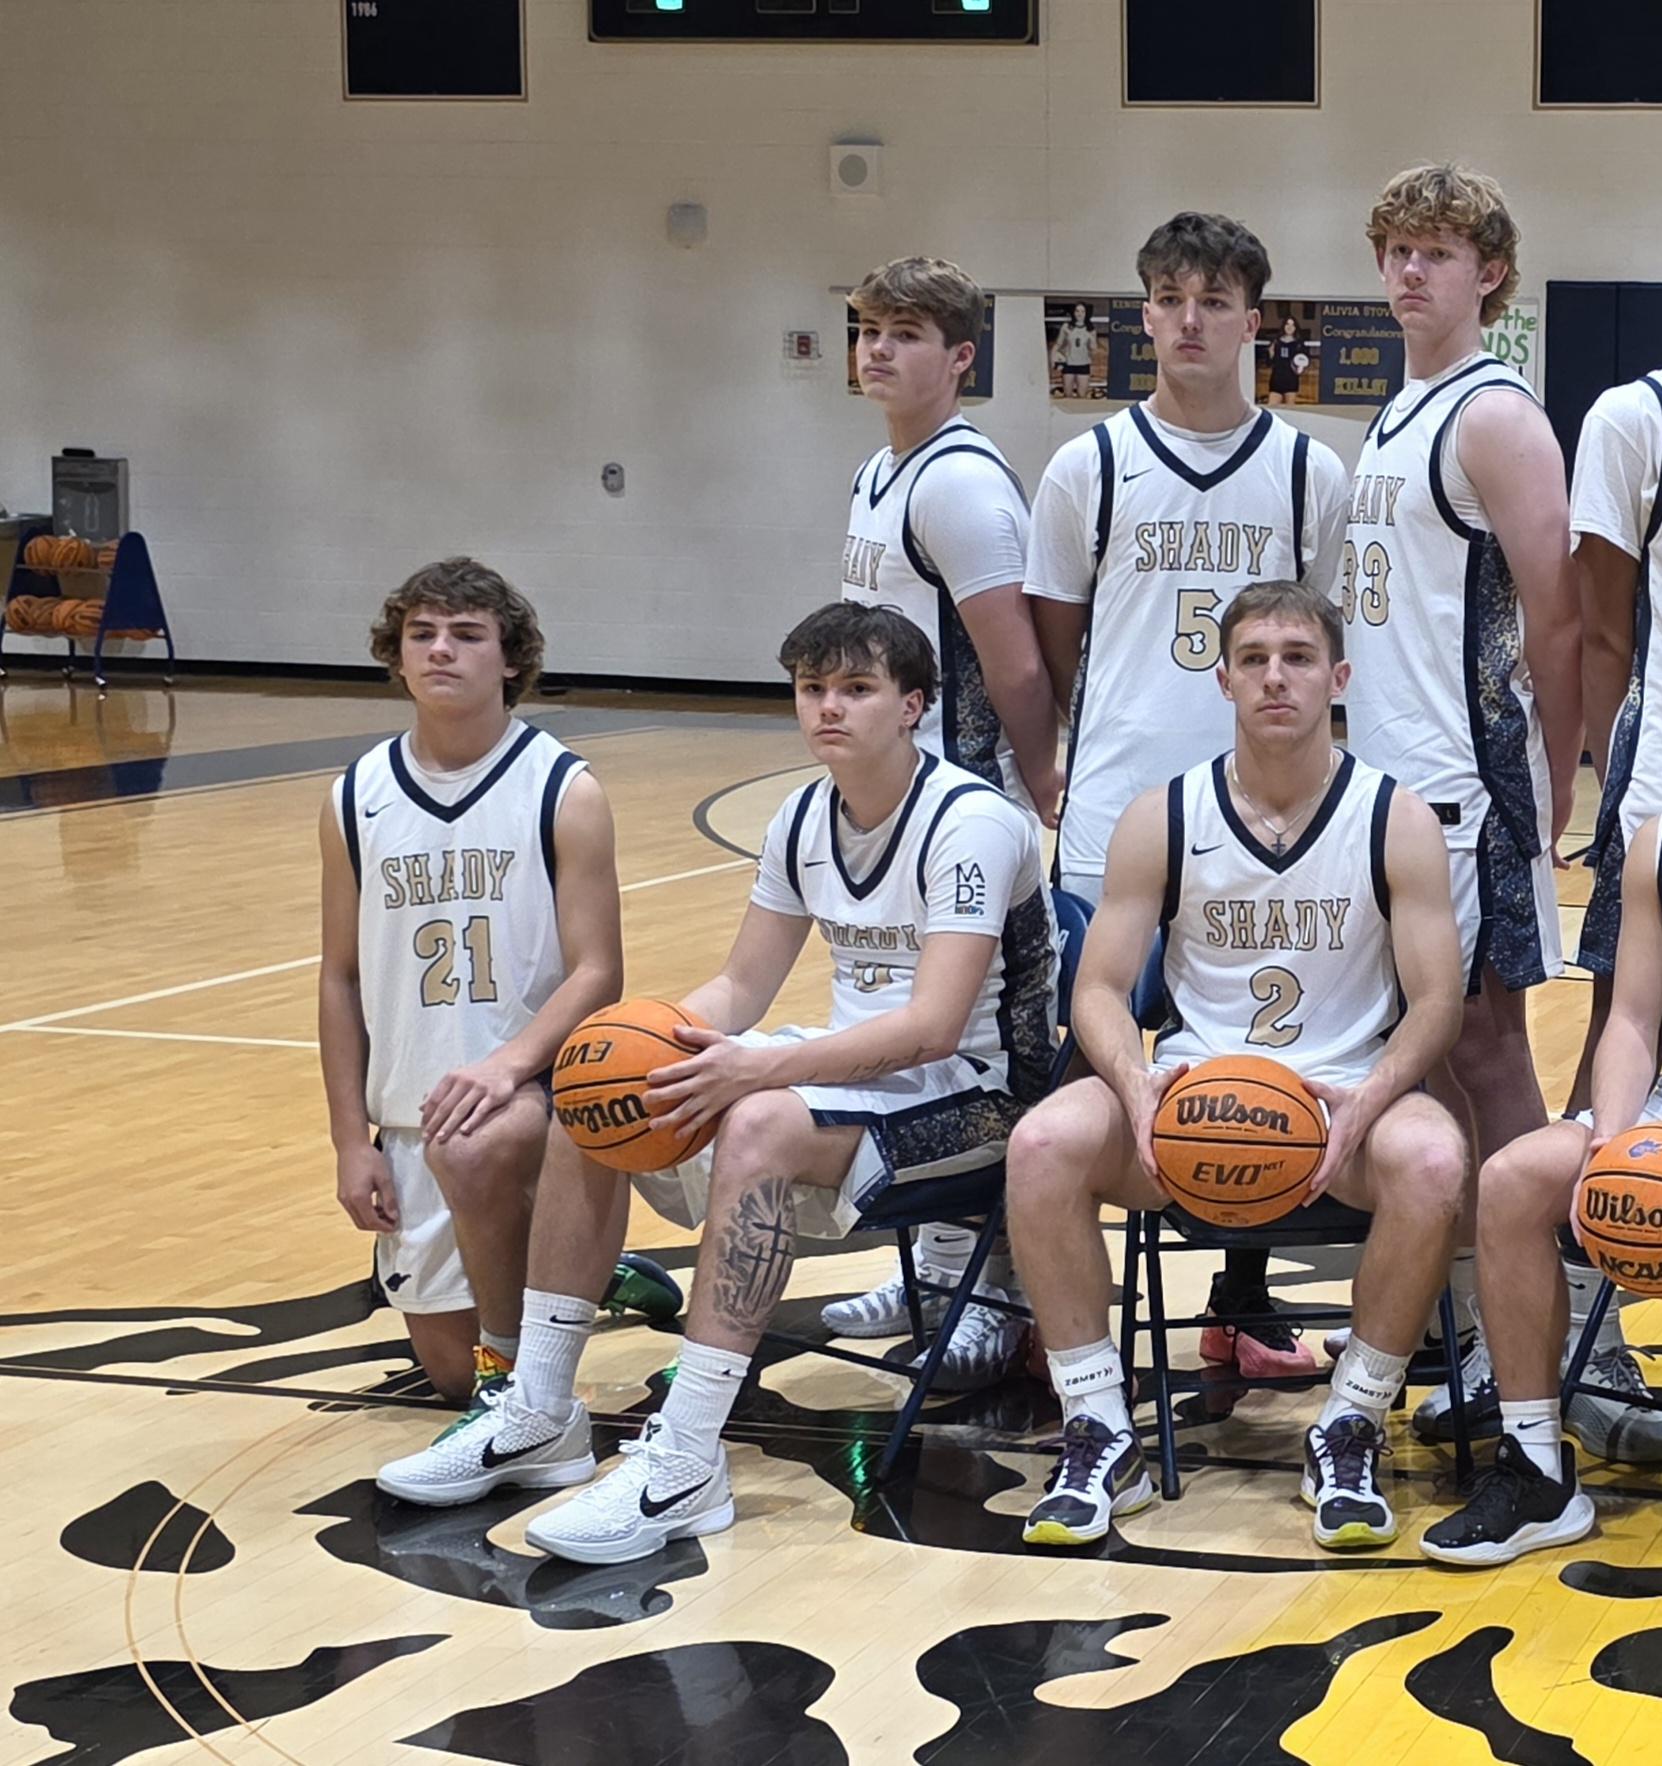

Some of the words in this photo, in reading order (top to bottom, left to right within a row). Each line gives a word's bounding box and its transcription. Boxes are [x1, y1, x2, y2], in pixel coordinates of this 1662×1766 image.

[351, 2, 378, 17] 1986
[1322, 305, 1360, 316] ALIVIA
[1502, 308, 1537, 331] the
[1135, 521, 1273, 576] SHADY
[1172, 589, 1222, 671] 5
[381, 848, 515, 909] SHADY
[1203, 898, 1351, 951] SHADY
[413, 915, 498, 1007] 21
[1245, 965, 1305, 1048] 2
[1177, 1093, 1290, 1135] Wilson
